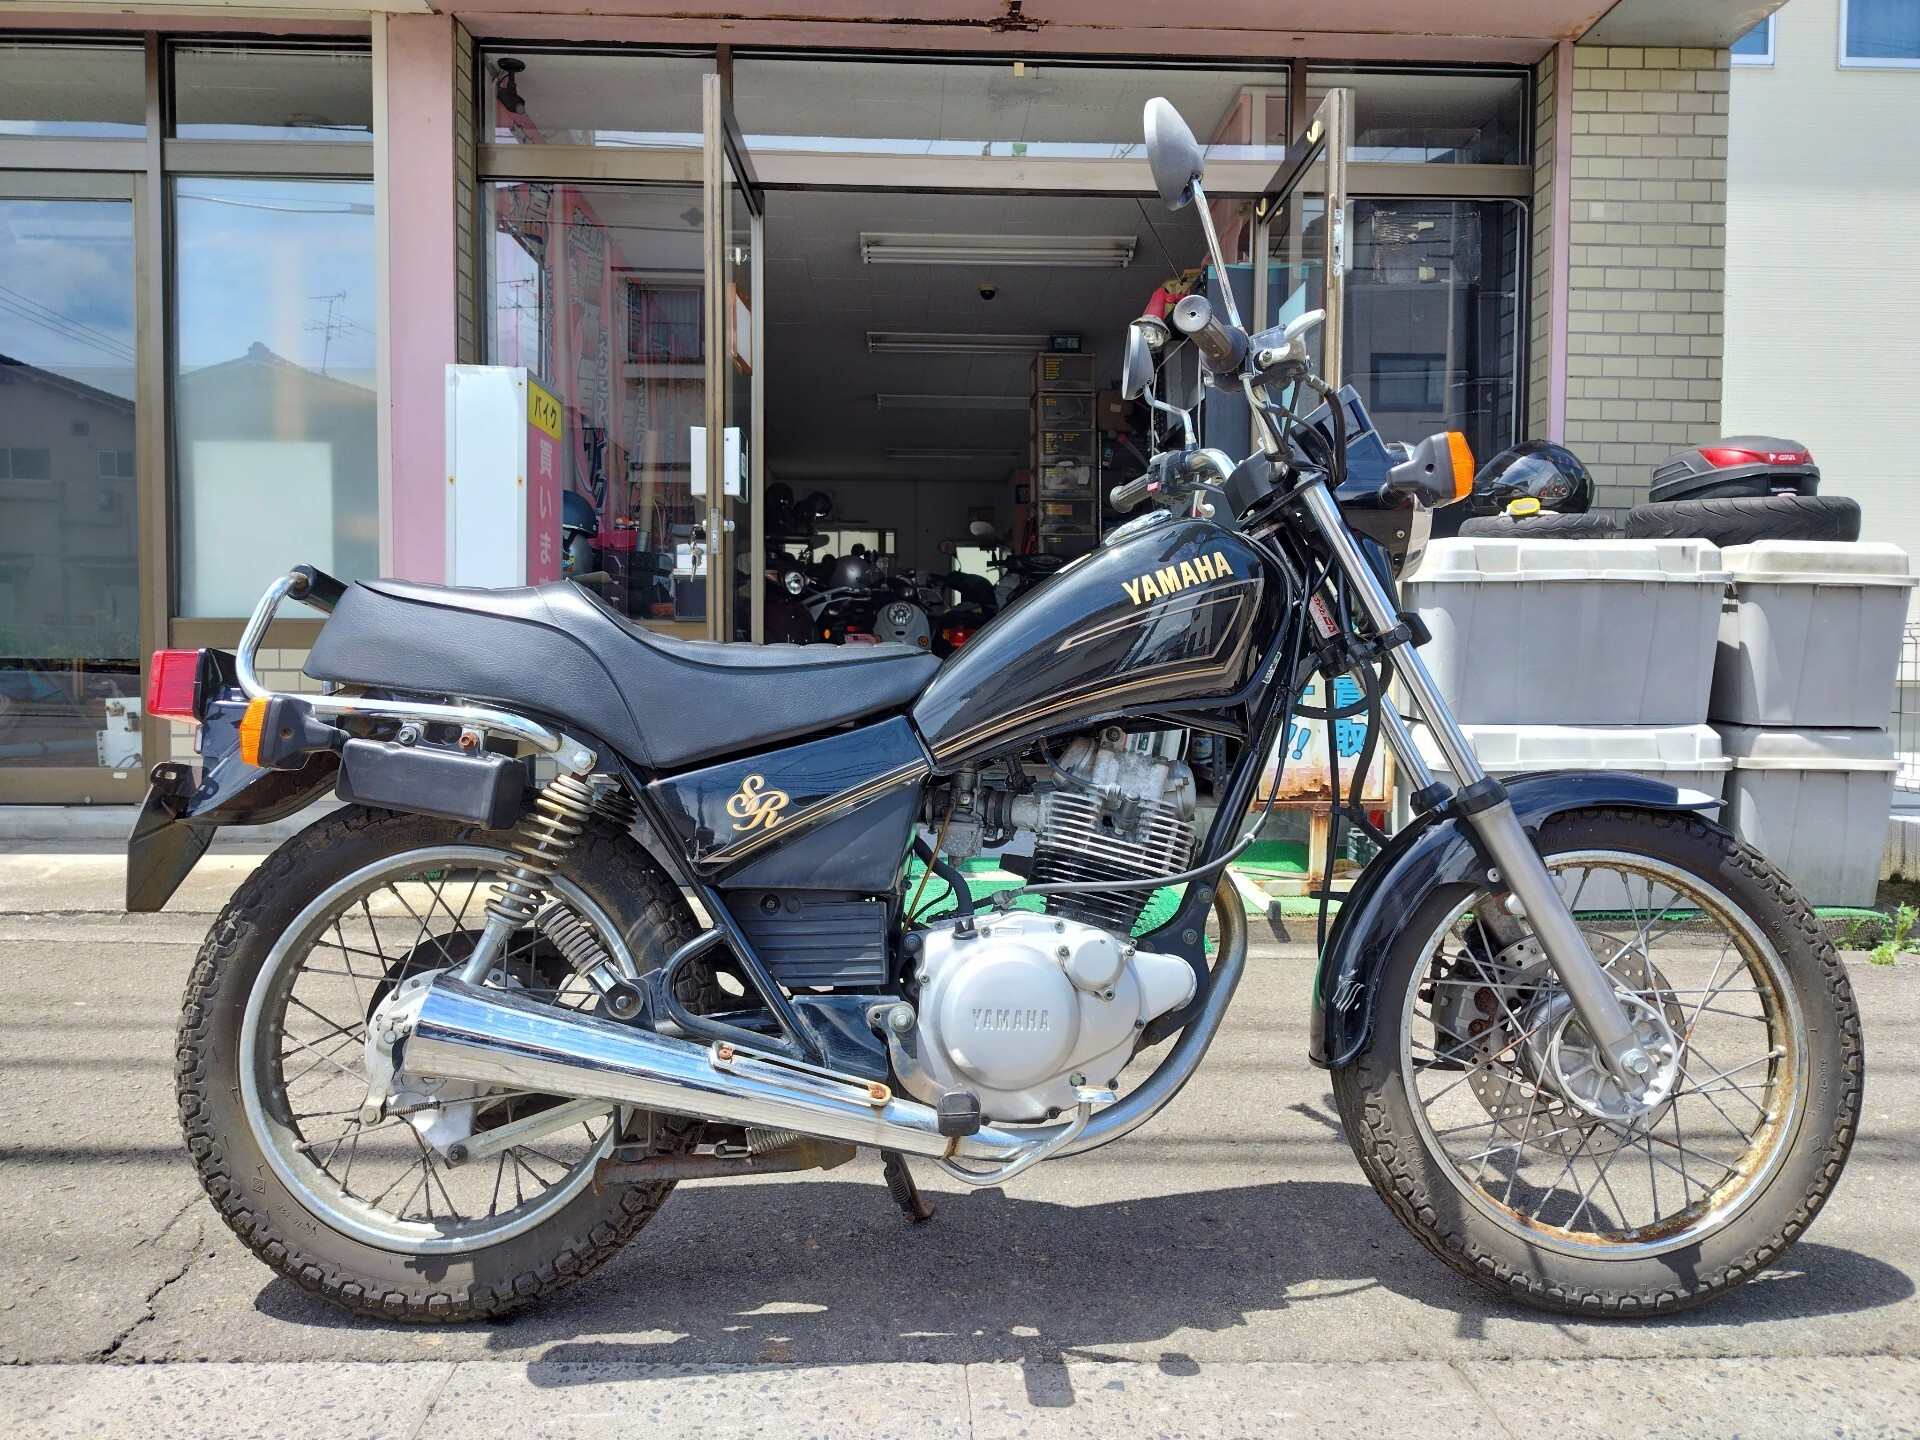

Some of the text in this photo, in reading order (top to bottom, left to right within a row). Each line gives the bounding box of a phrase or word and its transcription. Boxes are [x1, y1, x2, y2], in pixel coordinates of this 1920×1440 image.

[534, 395, 557, 430] バイク
[538, 438, 554, 584] 買いま
[1121, 551, 1234, 606] YAMAHA
[726, 774, 790, 831] SR
[972, 1008, 1050, 1031] YAMAHA
